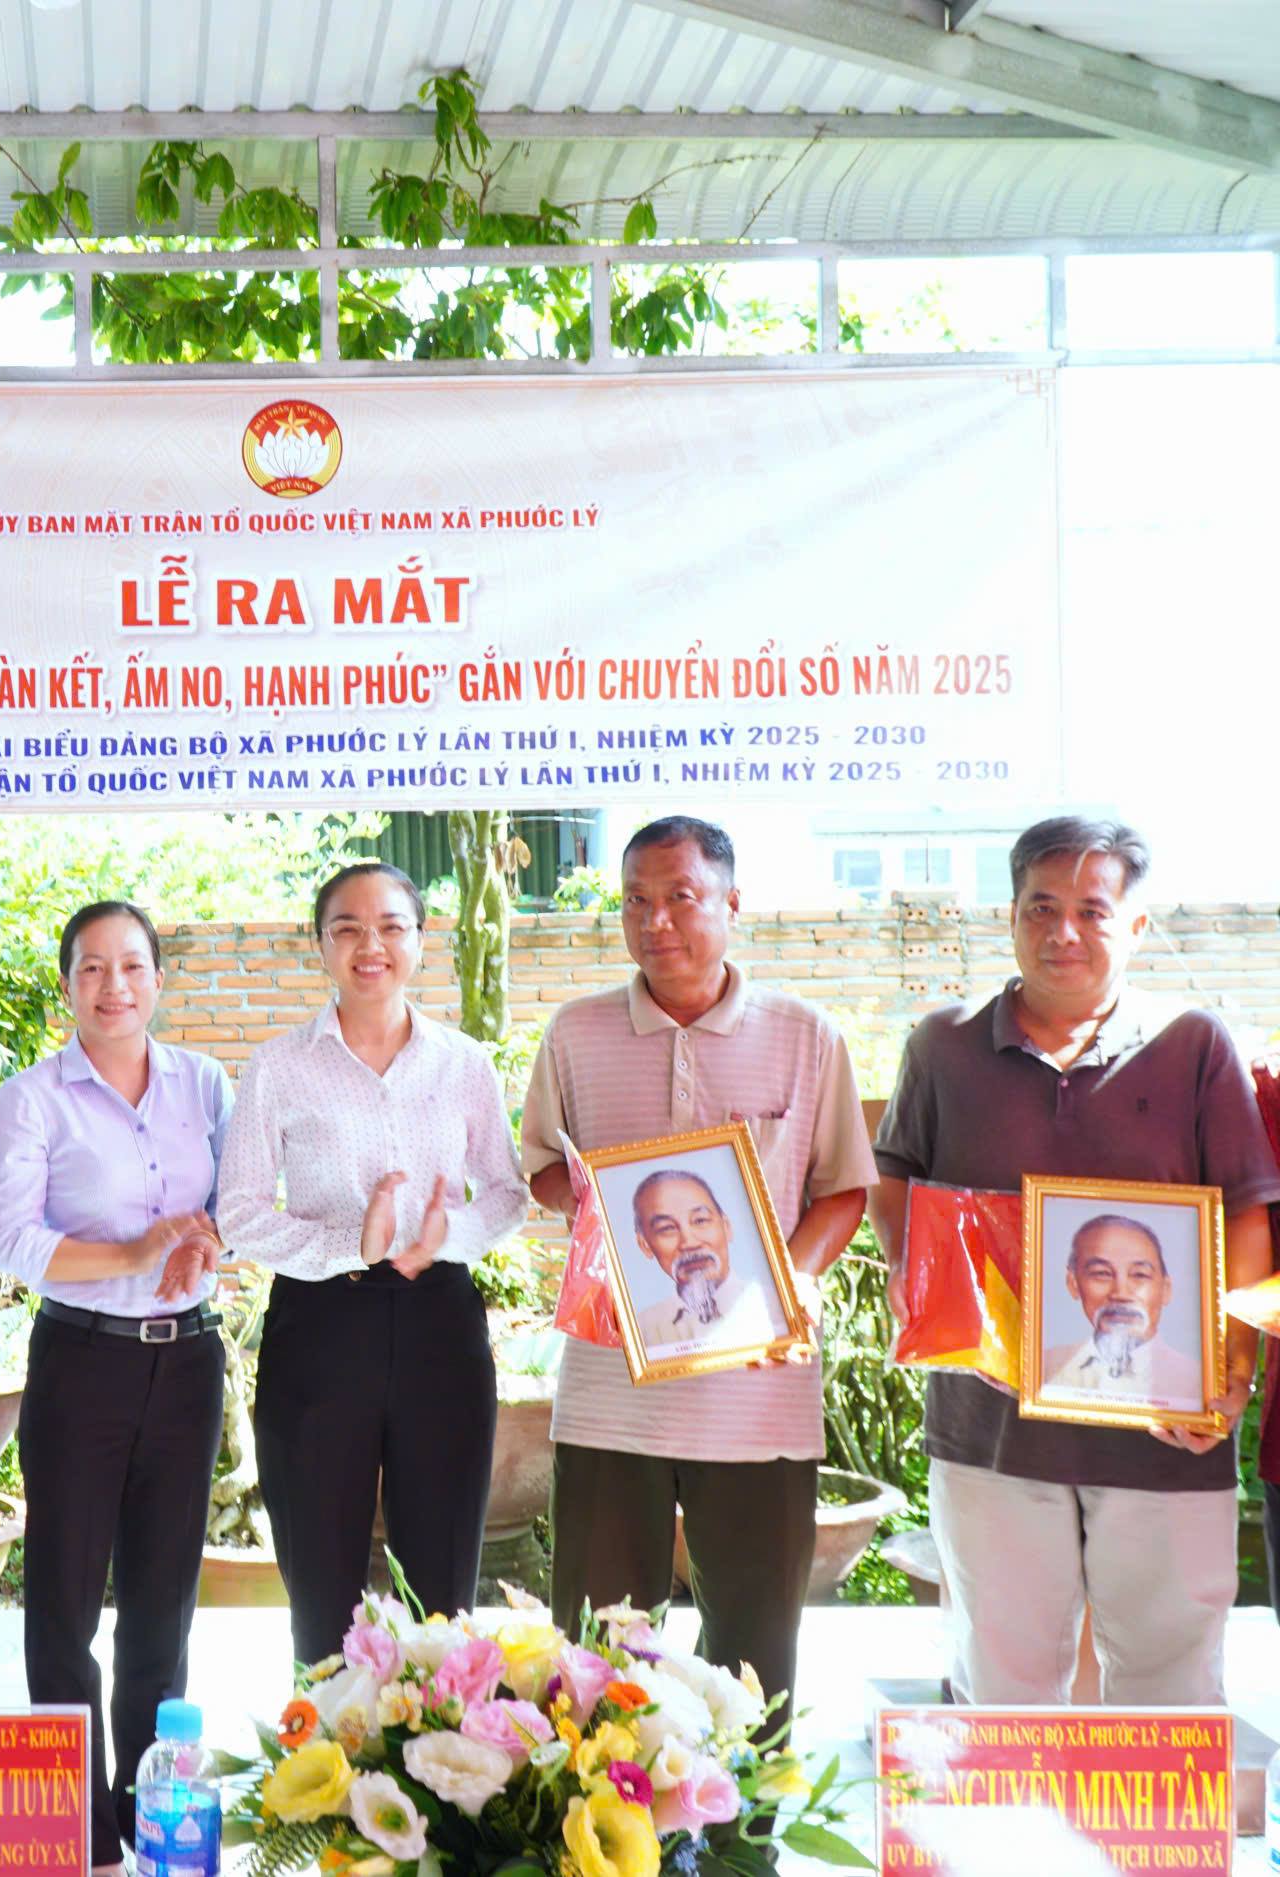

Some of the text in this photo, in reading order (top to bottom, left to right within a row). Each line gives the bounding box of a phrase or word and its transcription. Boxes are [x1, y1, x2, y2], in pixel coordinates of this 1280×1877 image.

[28, 515, 75, 533] BAN
[85, 511, 133, 537] MẶT
[141, 510, 202, 537] TRẬN
[211, 506, 241, 532] TỔ
[249, 506, 314, 534] QUỐC
[324, 508, 371, 535] VIỆT
[381, 512, 432, 529] NAM
[442, 506, 471, 529] XÃ
[480, 504, 564, 528] PHƯỚC
[573, 503, 598, 527] LÝ
[121, 555, 470, 626] LỄ RA MẮT
[49, 651, 112, 714] KẾT,
[123, 651, 169, 708] ẤM
[181, 666, 233, 713] NO,
[244, 665, 329, 717] HẠNH
[458, 645, 521, 701] GẮN
[533, 647, 585, 700] VỚI
[598, 639, 720, 701] CHUYỂN
[732, 638, 787, 698] ĐỔI
[800, 642, 840, 696] SỐ
[853, 644, 920, 695] NĂM
[933, 654, 1012, 695] 2025
[23, 728, 88, 757] BIỂU
[100, 731, 178, 757] ĐẢNG
[189, 731, 227, 760] BỘ
[239, 730, 275, 754] XÃ
[286, 728, 386, 753] PHƯỚC
[398, 726, 429, 751] LÝ
[440, 723, 491, 751] LẦN
[501, 725, 559, 750] THỨ
[569, 730, 586, 752] I,
[597, 724, 688, 753] NHIỆM
[700, 722, 735, 746] KỲ
[748, 726, 820, 745] 2025
[853, 726, 926, 745] 2030
[42, 763, 78, 793] TỔ
[87, 764, 168, 794] QUỐC
[179, 765, 238, 795] VIỆT
[248, 770, 309, 789] NAM
[320, 763, 356, 788] XÃ
[367, 761, 467, 787] PHƯỚC
[479, 761, 508, 786] LÝ
[520, 759, 572, 785] LẦN
[583, 759, 641, 783] THỨ
[653, 763, 670, 785] I,
[681, 757, 770, 786] NHIỆM
[782, 757, 816, 781] KỲ
[829, 761, 901, 781] 2025
[937, 760, 1009, 780] 2030
[1, 1723, 19, 1748] LÝ
[1002, 1720, 1041, 1746] ĐẢNG
[1044, 1722, 1065, 1751] BỘ
[1066, 1721, 1086, 1747] XÃ
[1089, 1721, 1139, 1747] PHƯỚC
[1141, 1721, 1160, 1747] LÝ
[8, 1753, 81, 1817] TUYỀN
[1074, 1770, 1155, 1831] MINH
[1161, 1752, 1227, 1831] TÂM
[28, 1837, 52, 1867] ỦY
[55, 1838, 78, 1867] XÃ
[887, 1843, 910, 1867] UV
[1109, 1844, 1150, 1872] TỊCH
[1153, 1844, 1198, 1868] UBND
[1201, 1839, 1224, 1868] XÃ
